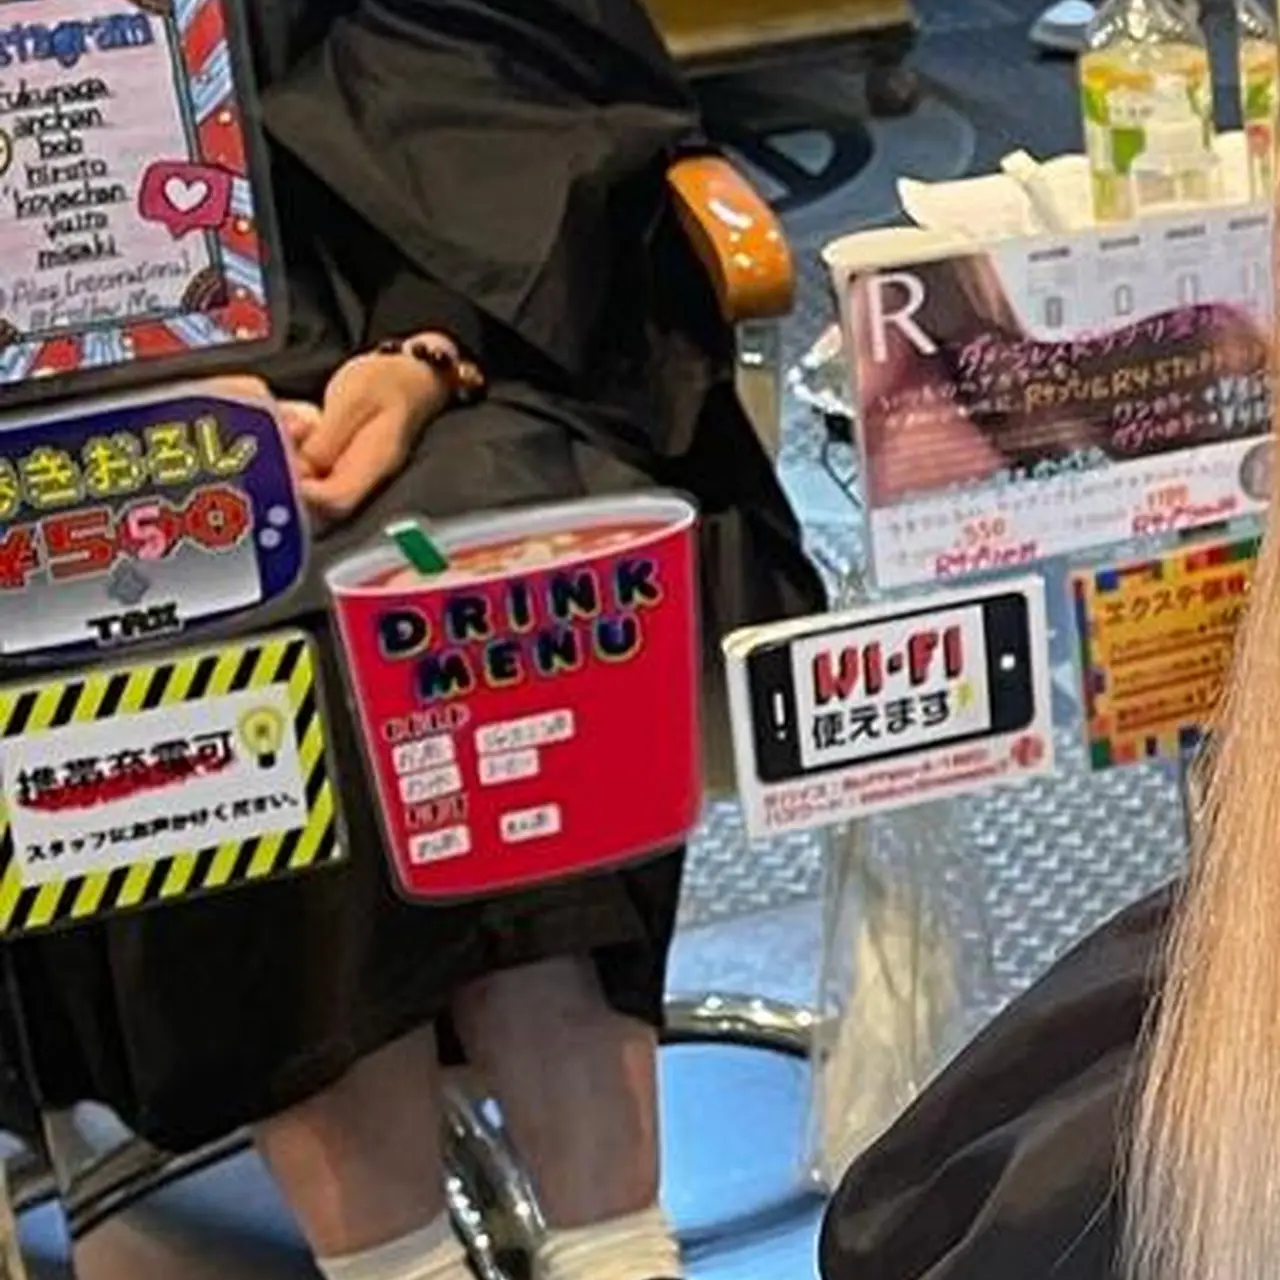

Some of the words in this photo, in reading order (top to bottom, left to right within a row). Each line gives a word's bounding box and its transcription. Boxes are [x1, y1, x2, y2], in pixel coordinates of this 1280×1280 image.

[865, 272, 938, 362] R
[376, 556, 664, 659] DRINK
[415, 612, 642, 704] MENU
[811, 689, 951, 750] 使えます
